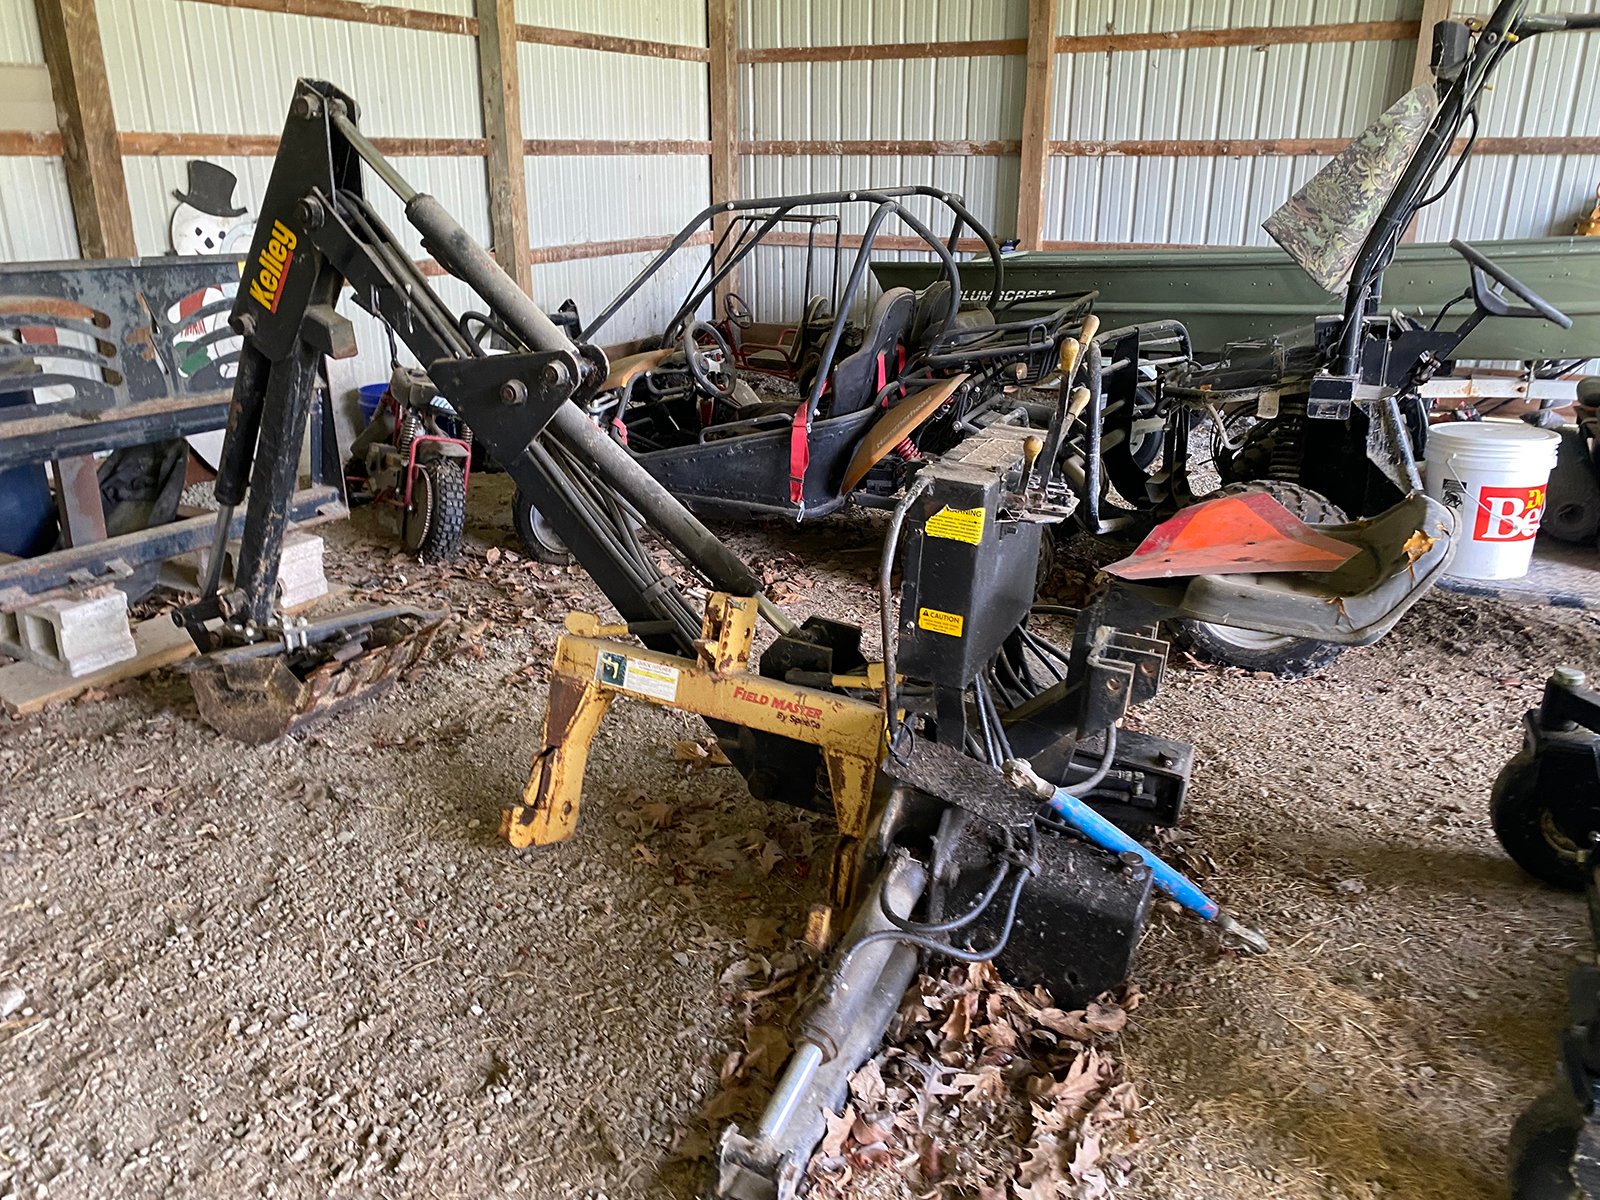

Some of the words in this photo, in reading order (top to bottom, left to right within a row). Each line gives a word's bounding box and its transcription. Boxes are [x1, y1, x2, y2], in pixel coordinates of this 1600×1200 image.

[249, 219, 297, 310] Kelley
[930, 612, 960, 623] CAUTION
[733, 686, 769, 705] FIELD
[770, 696, 822, 719] MASTER
